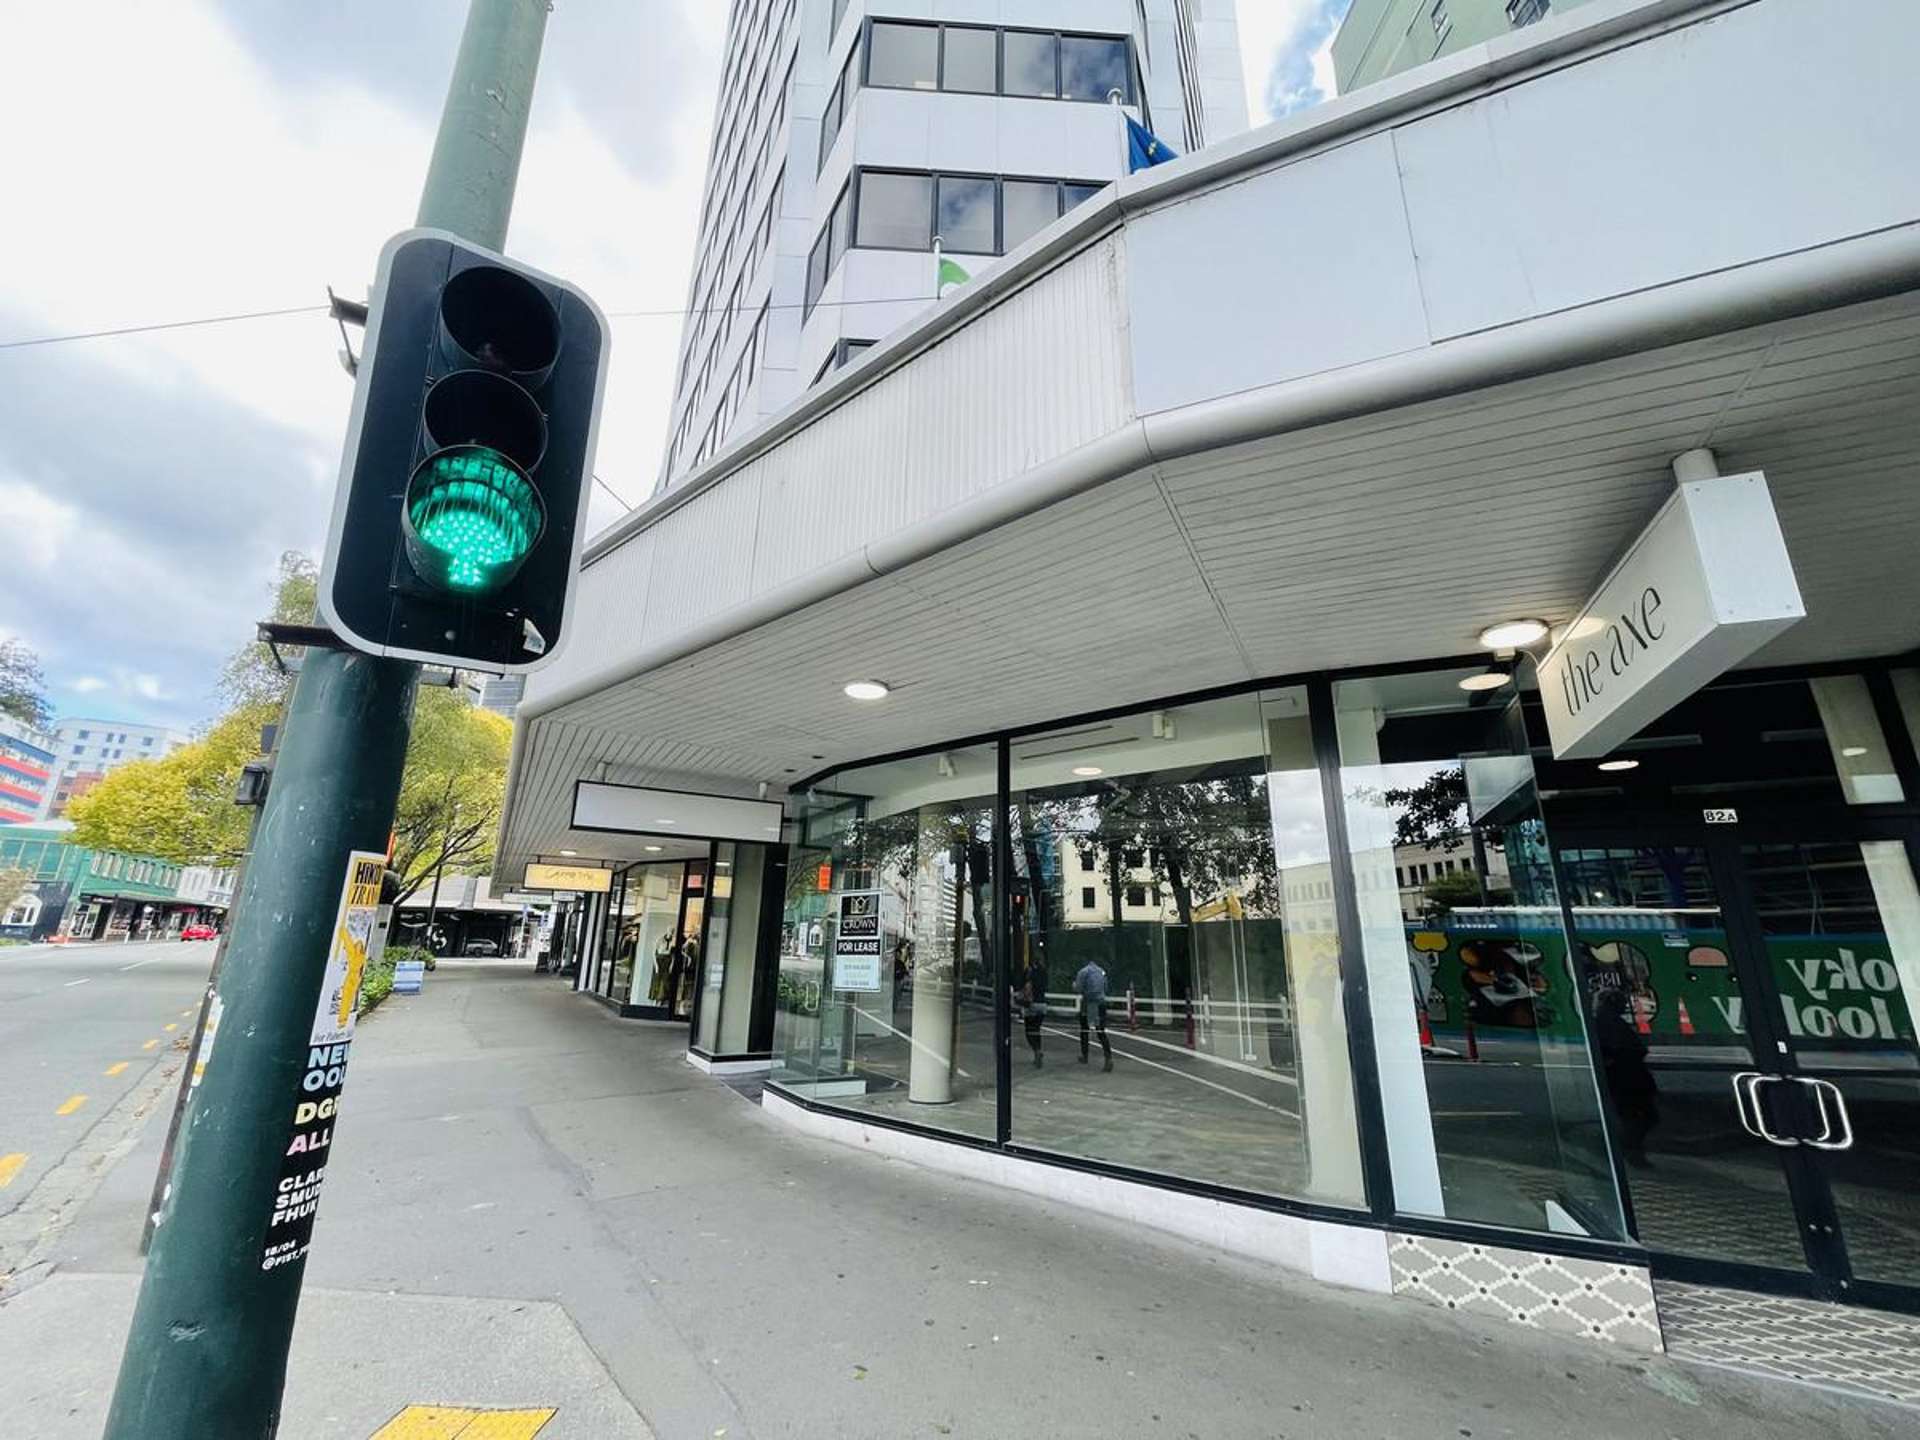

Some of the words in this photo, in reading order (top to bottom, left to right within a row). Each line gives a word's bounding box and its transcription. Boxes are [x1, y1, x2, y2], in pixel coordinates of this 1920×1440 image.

[1561, 651, 1603, 716] the
[1606, 588, 1665, 676] axe
[1705, 810, 1736, 822] 82A
[842, 919, 876, 930] CROWN
[838, 942, 853, 952] FOR
[854, 942, 878, 952] LEASE
[303, 1065, 345, 1091] OO
[286, 1127, 330, 1156] ALL
